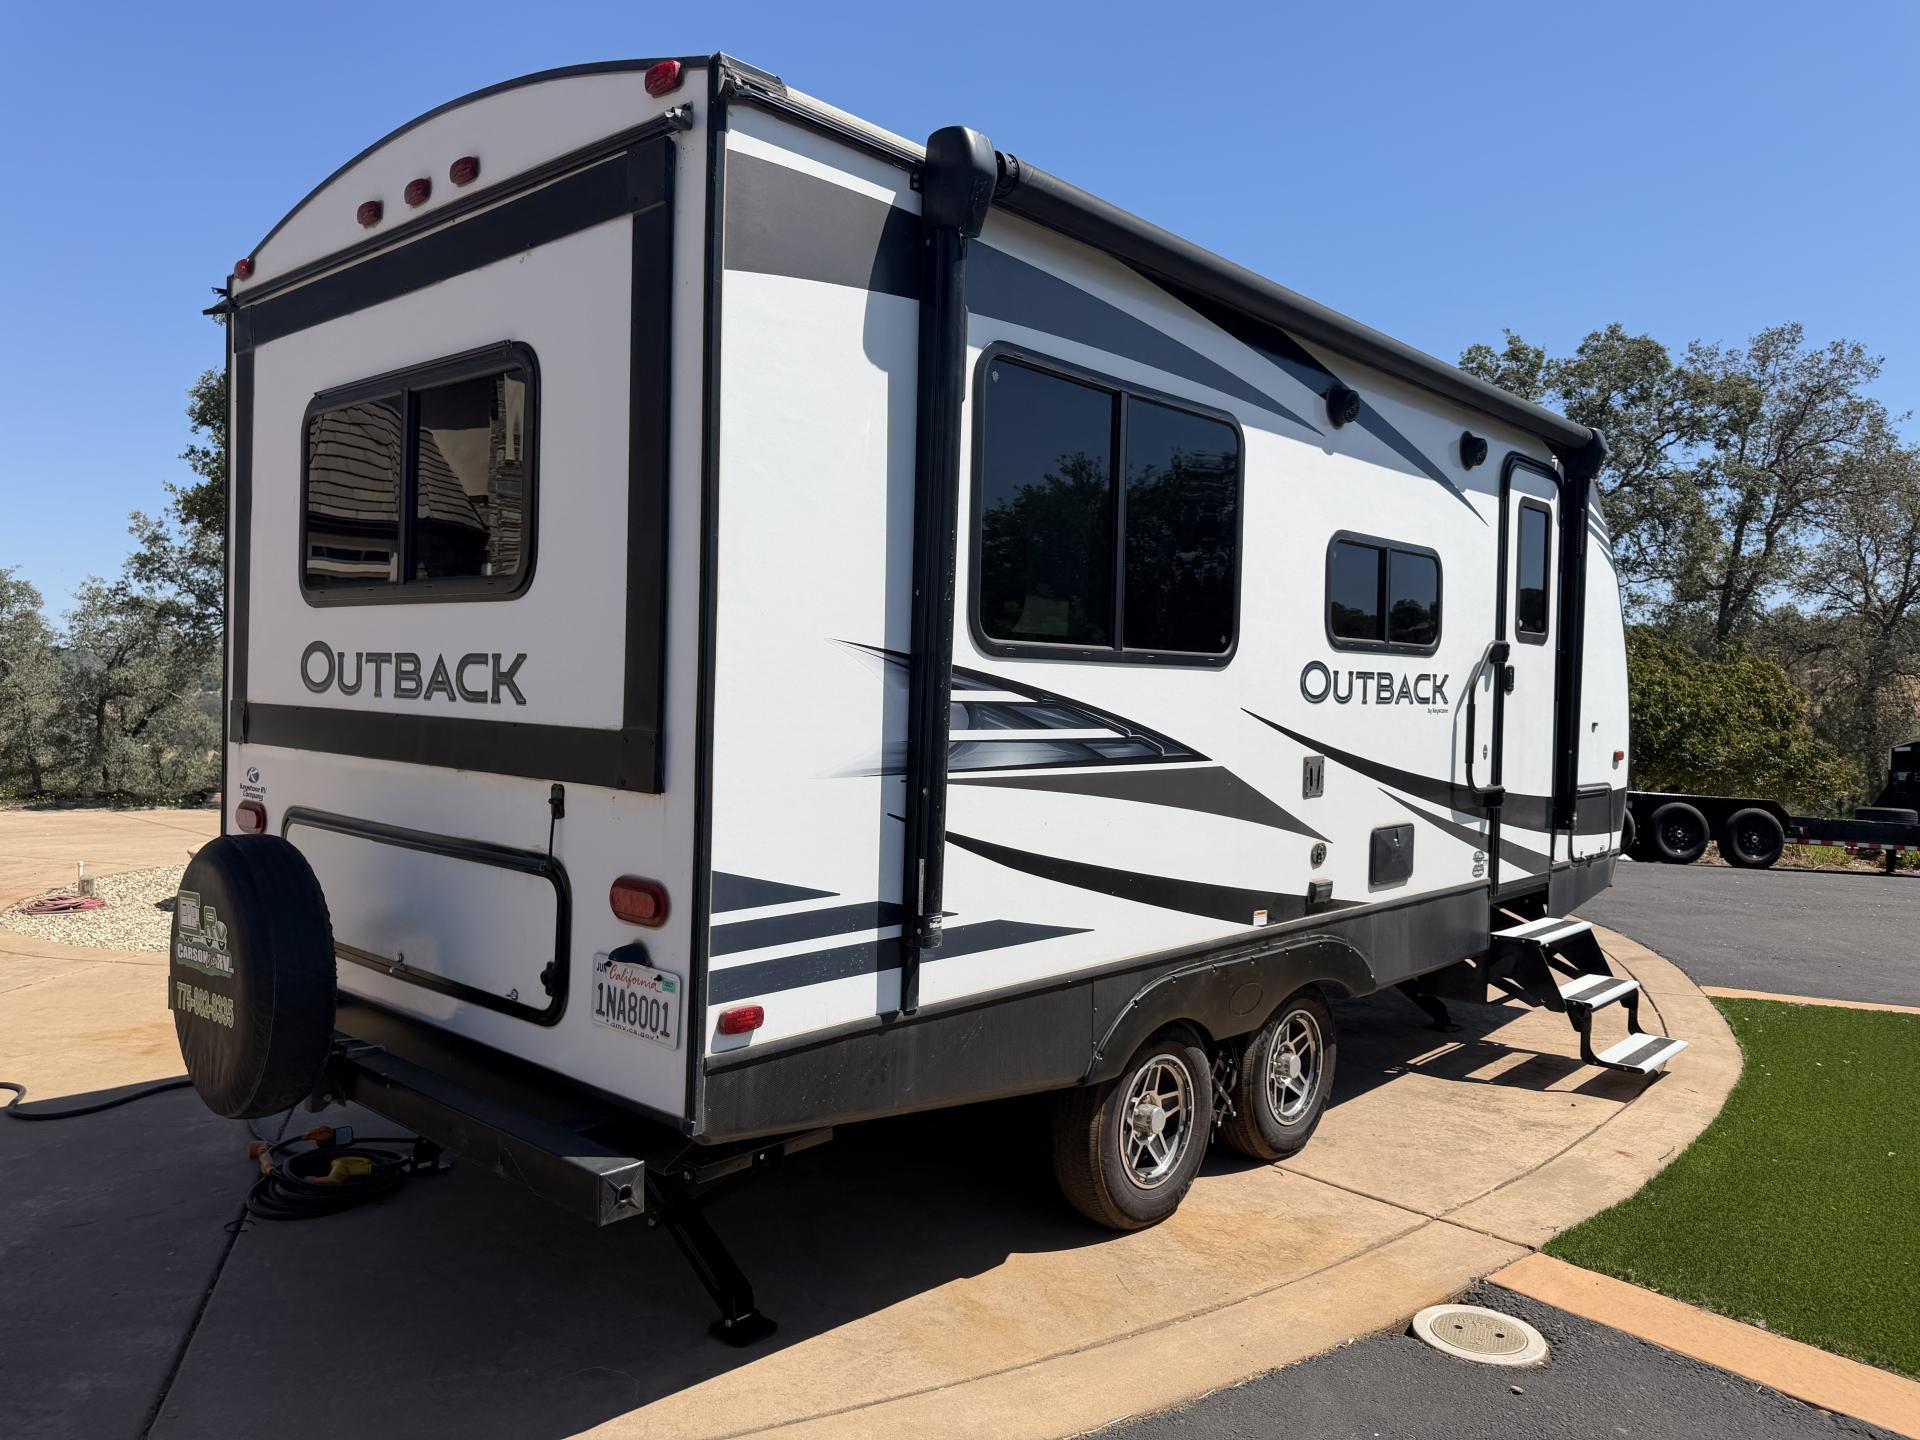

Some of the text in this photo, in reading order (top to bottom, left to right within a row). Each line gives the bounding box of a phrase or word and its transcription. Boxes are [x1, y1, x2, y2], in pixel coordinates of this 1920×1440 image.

[300, 640, 527, 706] OUTBACK
[1299, 660, 1449, 705] OUTBACK
[240, 783, 260, 793] Keystone
[243, 791, 263, 800] Company
[178, 944, 207, 963] CARSON
[217, 953, 230, 971] RV
[609, 963, 662, 993] California
[596, 982, 670, 1037] 1NA8001
[610, 1022, 654, 1040] dmv.ca.gov
